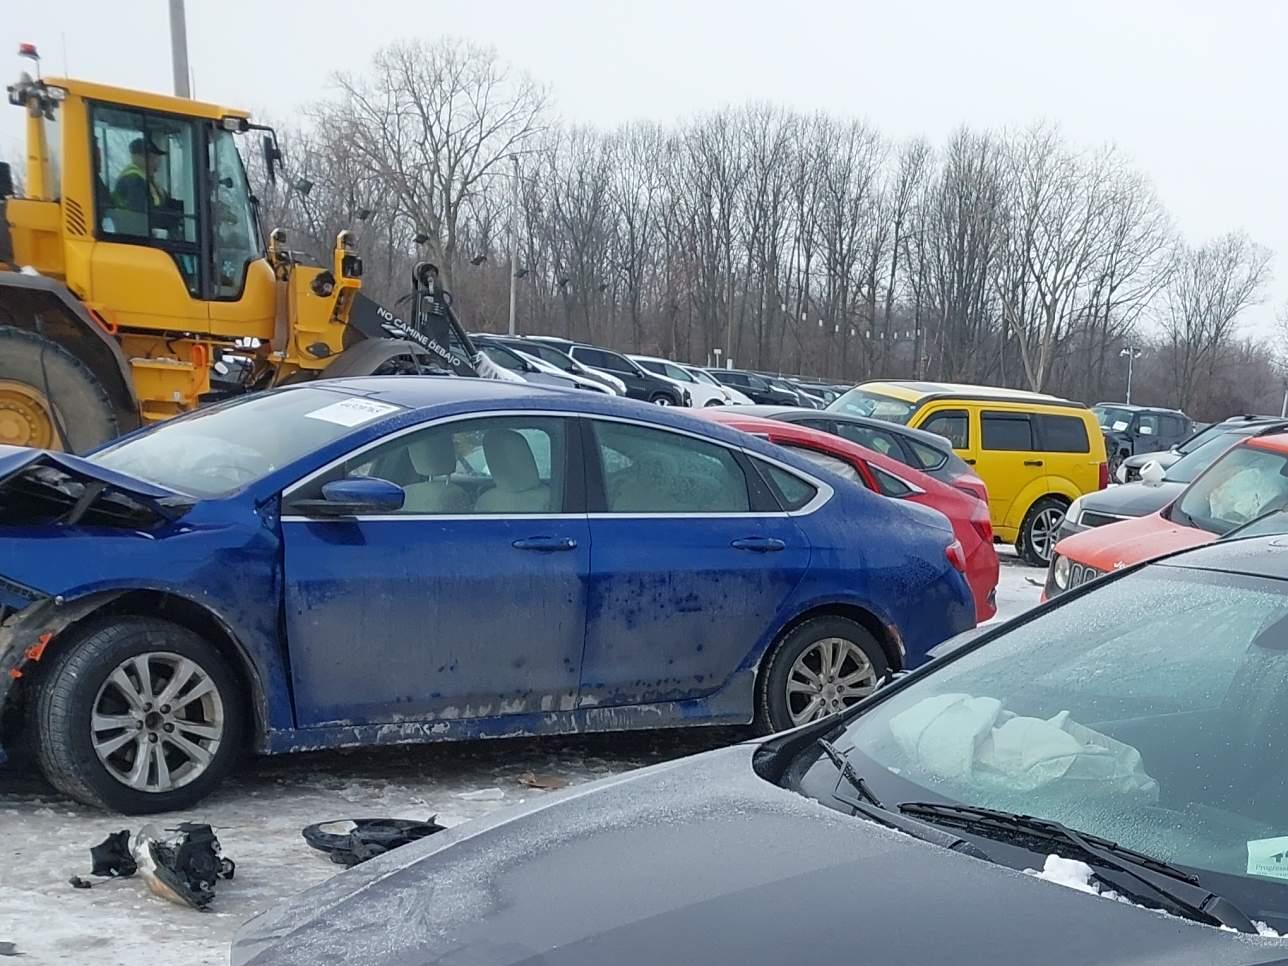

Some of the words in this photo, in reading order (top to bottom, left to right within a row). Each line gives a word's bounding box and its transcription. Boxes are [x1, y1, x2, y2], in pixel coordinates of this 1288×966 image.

[376, 306, 393, 321] NO
[393, 318, 429, 346] CAMINE
[428, 339, 461, 367] DEBAJO
